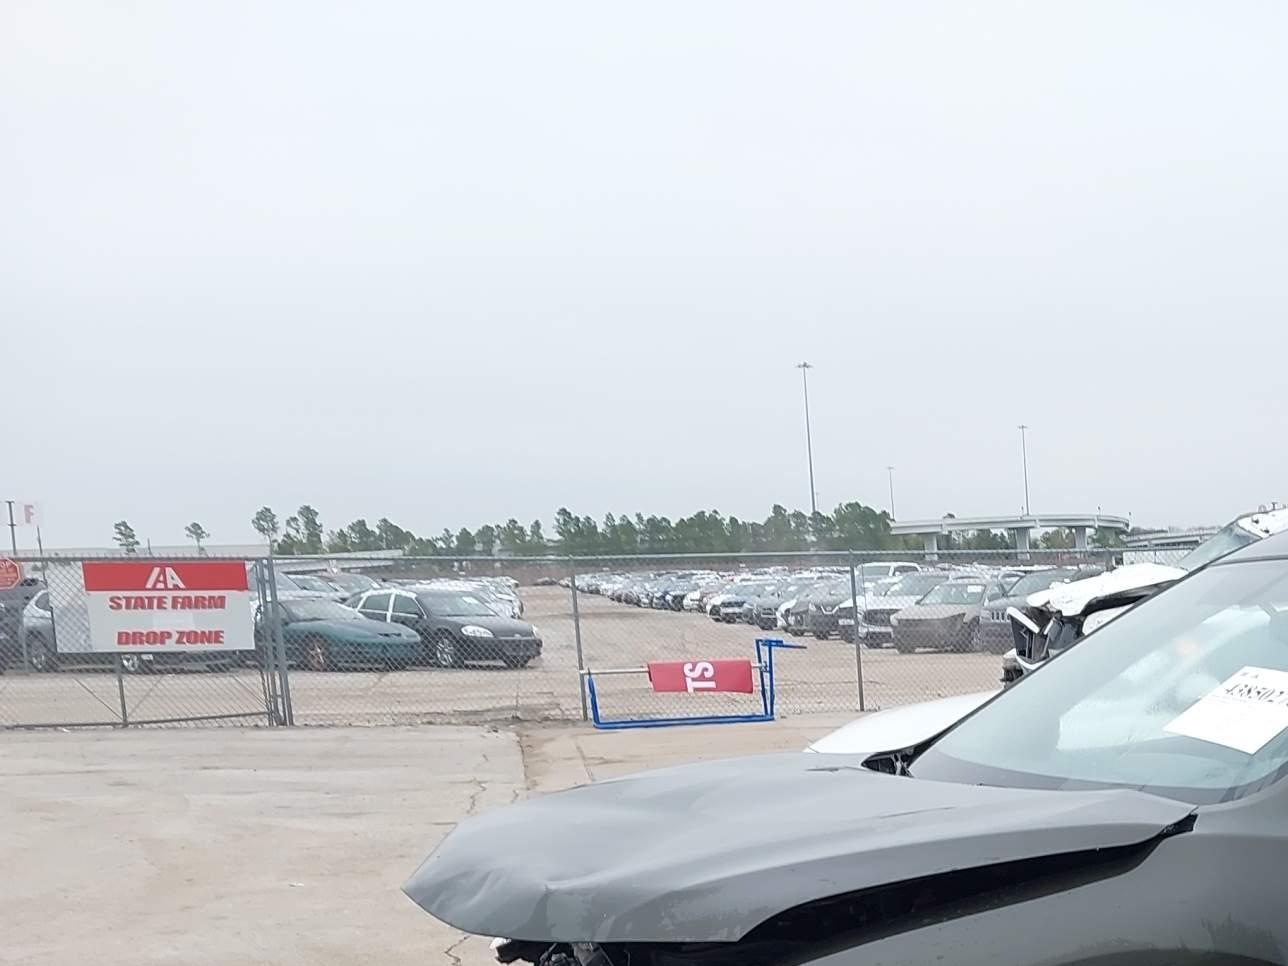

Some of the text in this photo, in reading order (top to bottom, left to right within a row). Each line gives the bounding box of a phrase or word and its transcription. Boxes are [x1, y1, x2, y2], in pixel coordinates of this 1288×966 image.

[108, 595, 227, 611] STATE FARM
[116, 629, 225, 646] DROP ZONE
